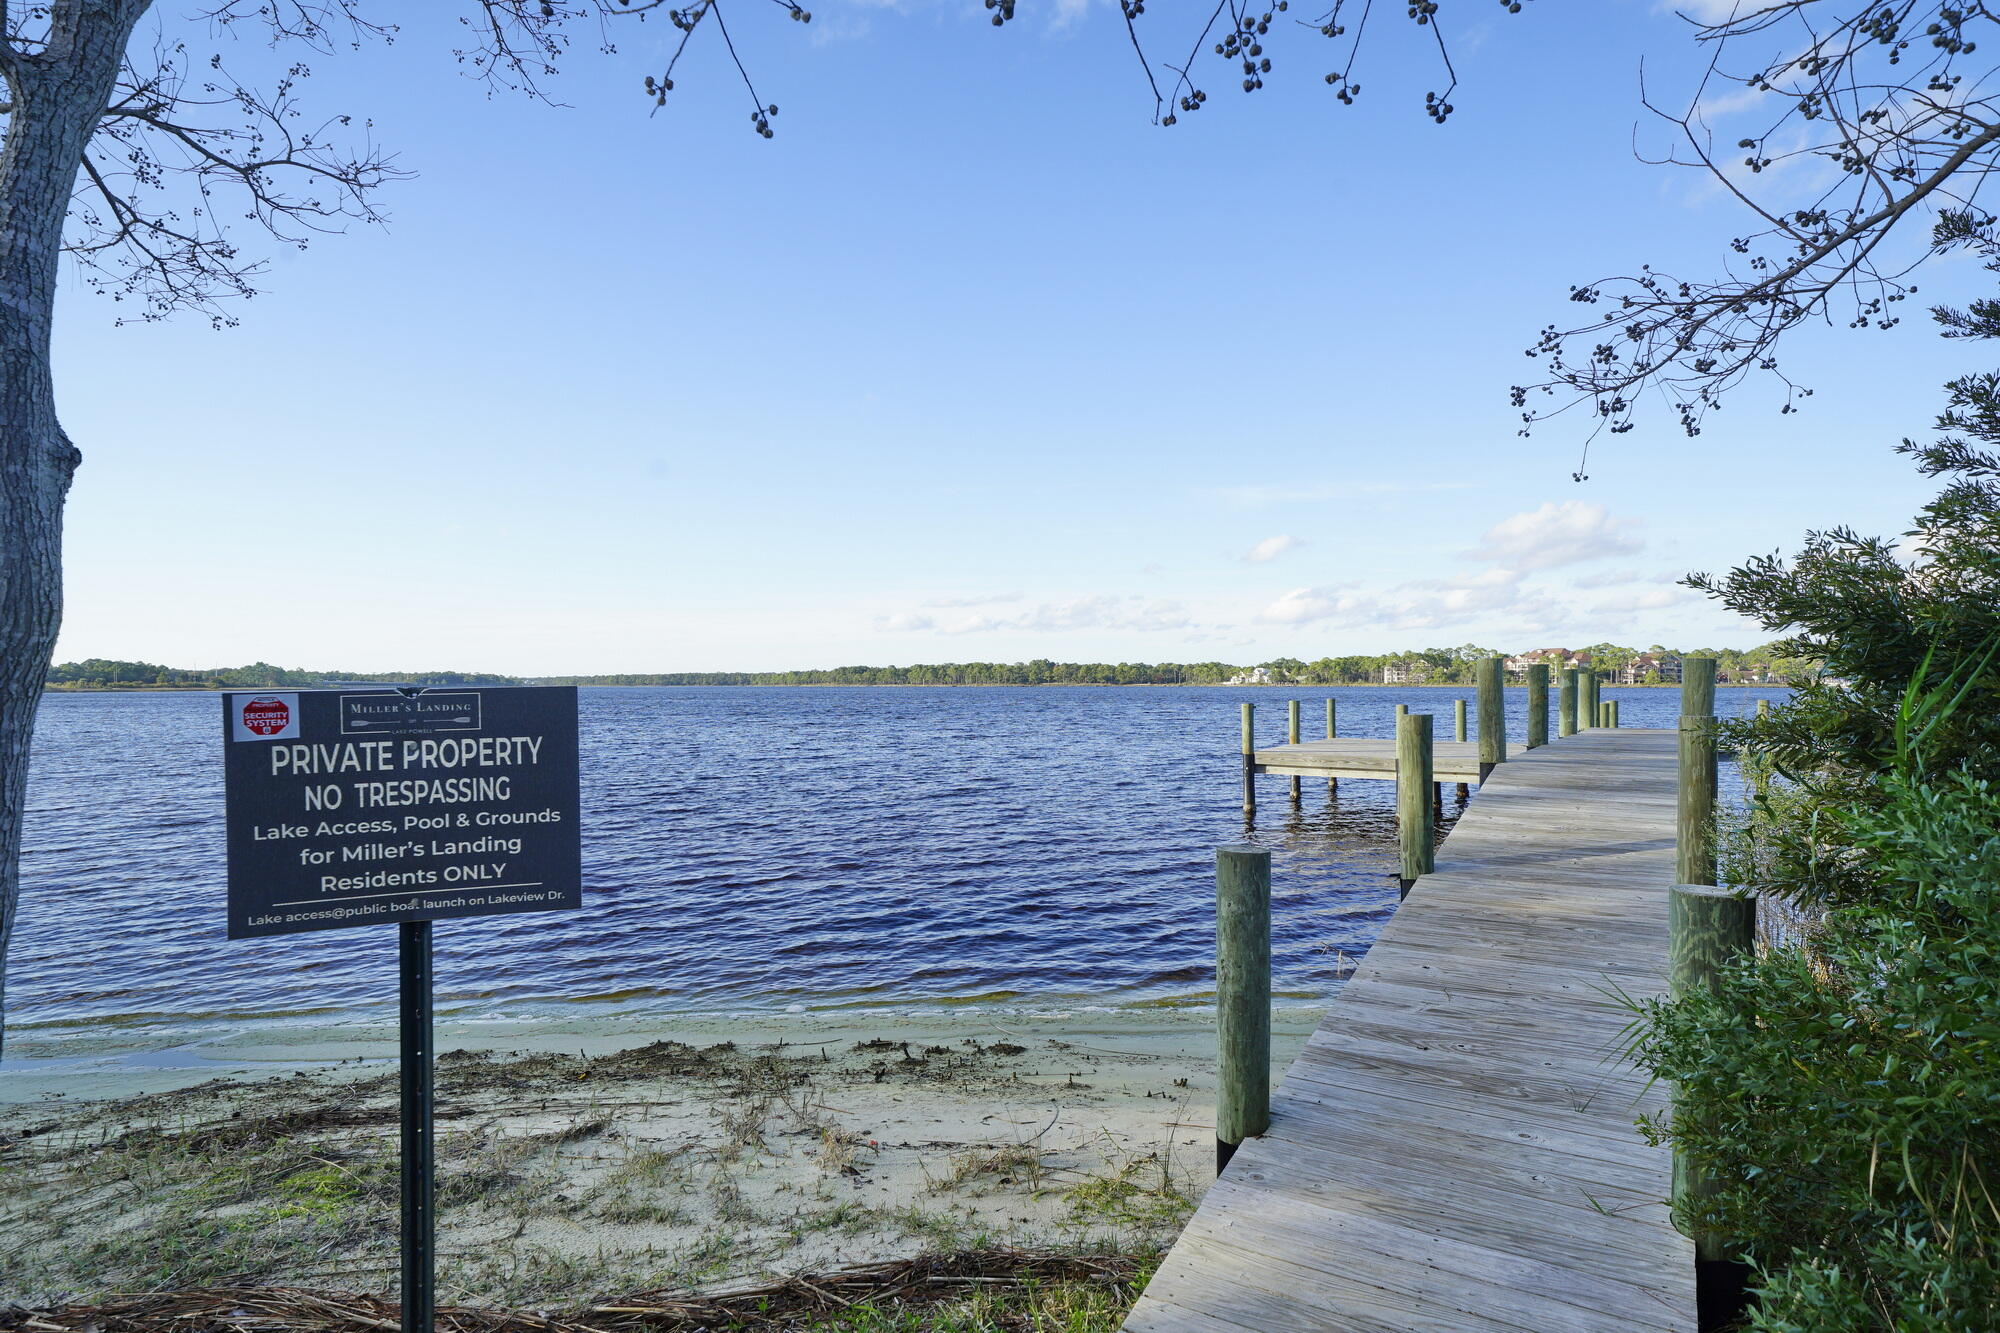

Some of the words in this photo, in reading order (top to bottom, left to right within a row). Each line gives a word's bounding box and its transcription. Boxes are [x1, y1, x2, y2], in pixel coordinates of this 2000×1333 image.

[244, 711, 288, 720] SECURITY
[417, 702, 472, 712] LANDING
[246, 719, 287, 727] SYSTEM
[271, 740, 394, 776] PRIVATE
[403, 735, 543, 770] PROPERTY
[304, 783, 343, 811] NO
[354, 776, 511, 808] TRESPASSING
[254, 823, 309, 841] Lake
[315, 817, 397, 837] Access,
[404, 813, 450, 831] Pool
[456, 812, 470, 827] &
[476, 808, 561, 826] Grounds
[300, 847, 335, 865] for
[342, 840, 424, 862] Miller's
[431, 835, 522, 857] Landing
[321, 869, 438, 892] Residents
[443, 862, 507, 882] ONLY
[247, 914, 282, 926] Lake
[286, 904, 387, 922] access@public
[423, 897, 466, 909] launch
[468, 896, 485, 906] on
[488, 892, 545, 904] Lakeview
[548, 890, 566, 900] Dr.
